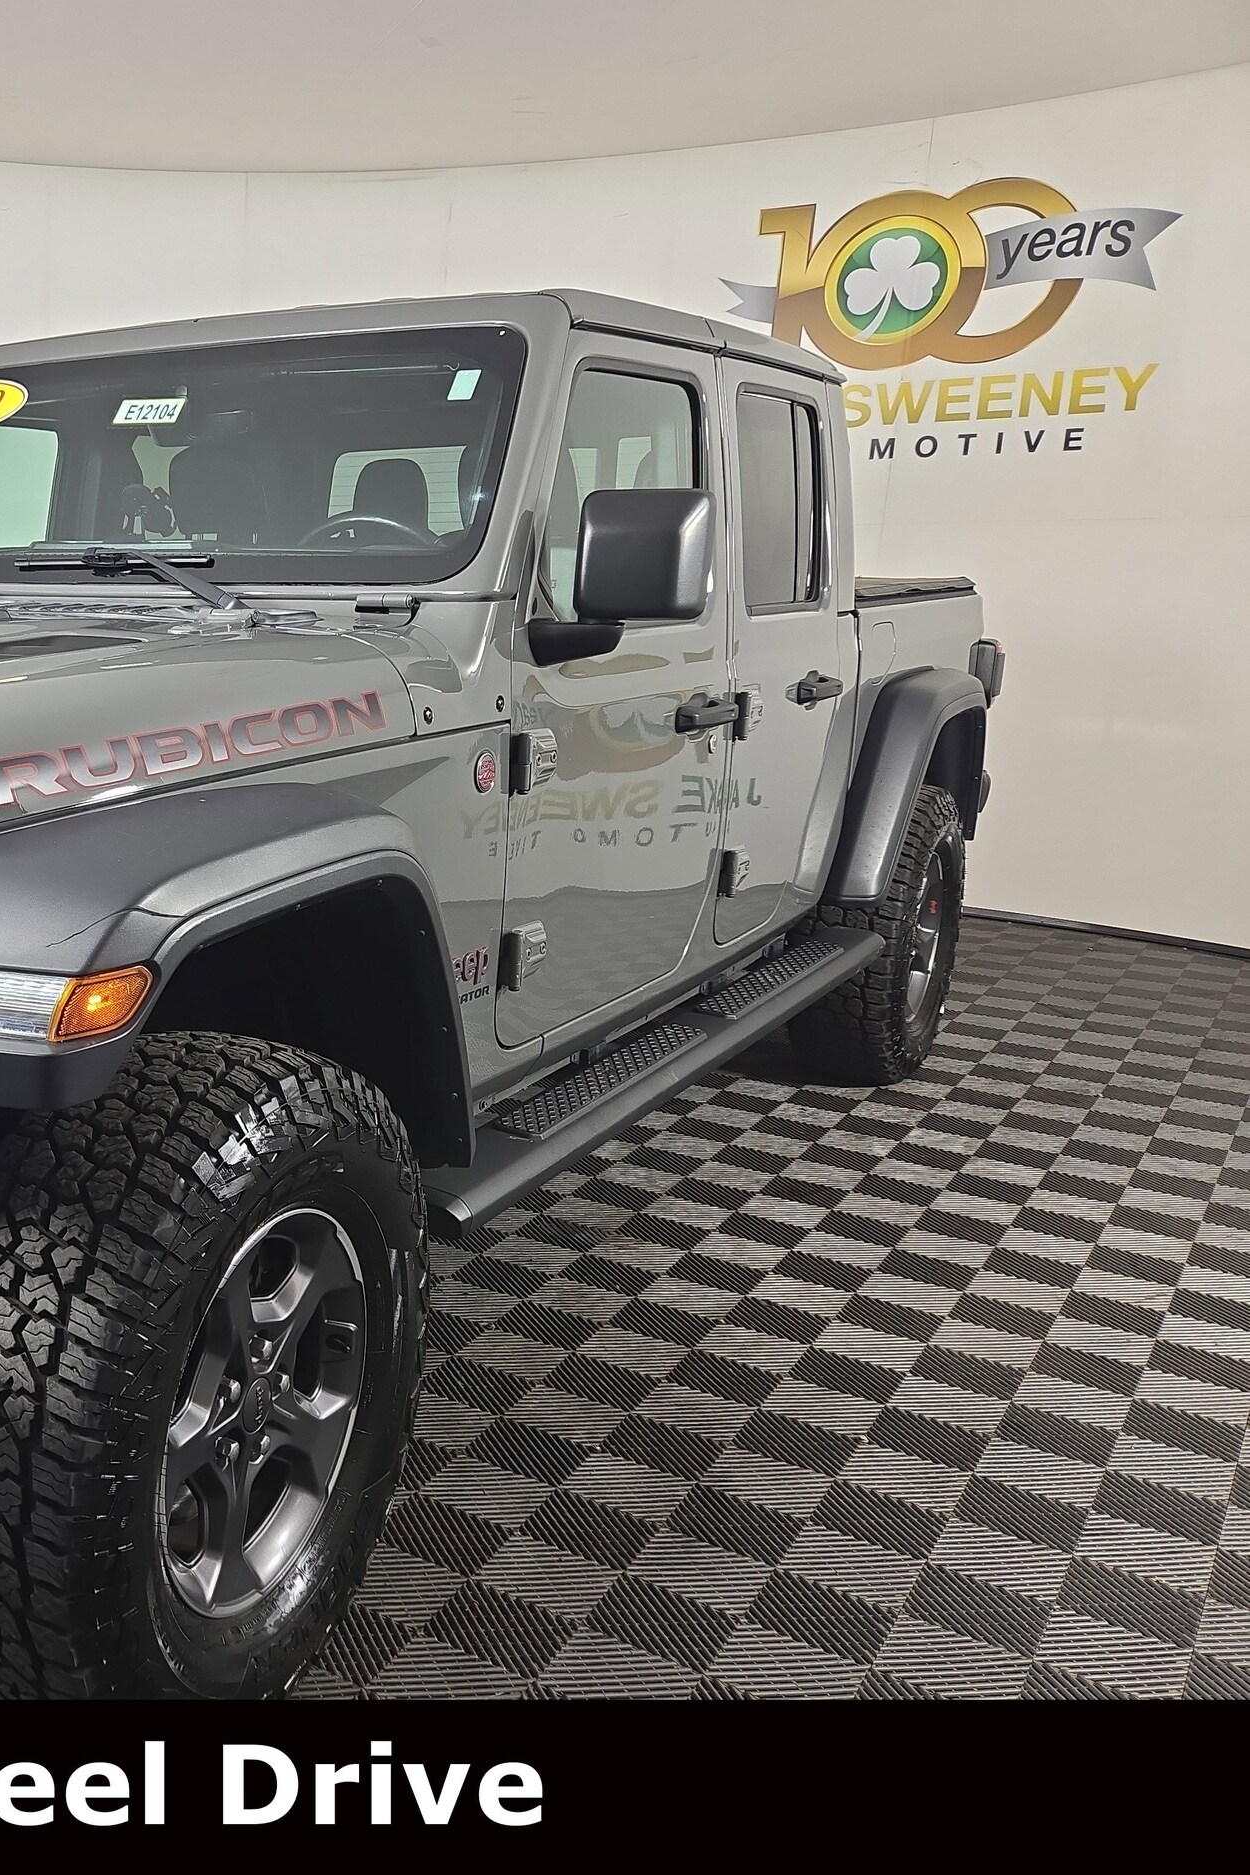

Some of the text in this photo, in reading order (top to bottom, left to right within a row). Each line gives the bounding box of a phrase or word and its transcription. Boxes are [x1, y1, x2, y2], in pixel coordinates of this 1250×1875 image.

[996, 218, 1136, 281] years
[124, 403, 179, 421] E12104
[842, 363, 1159, 428] SWEENEY
[868, 427, 1085, 461] MOTIVE
[452, 946, 489, 986] eep
[458, 985, 490, 1005] ATOR
